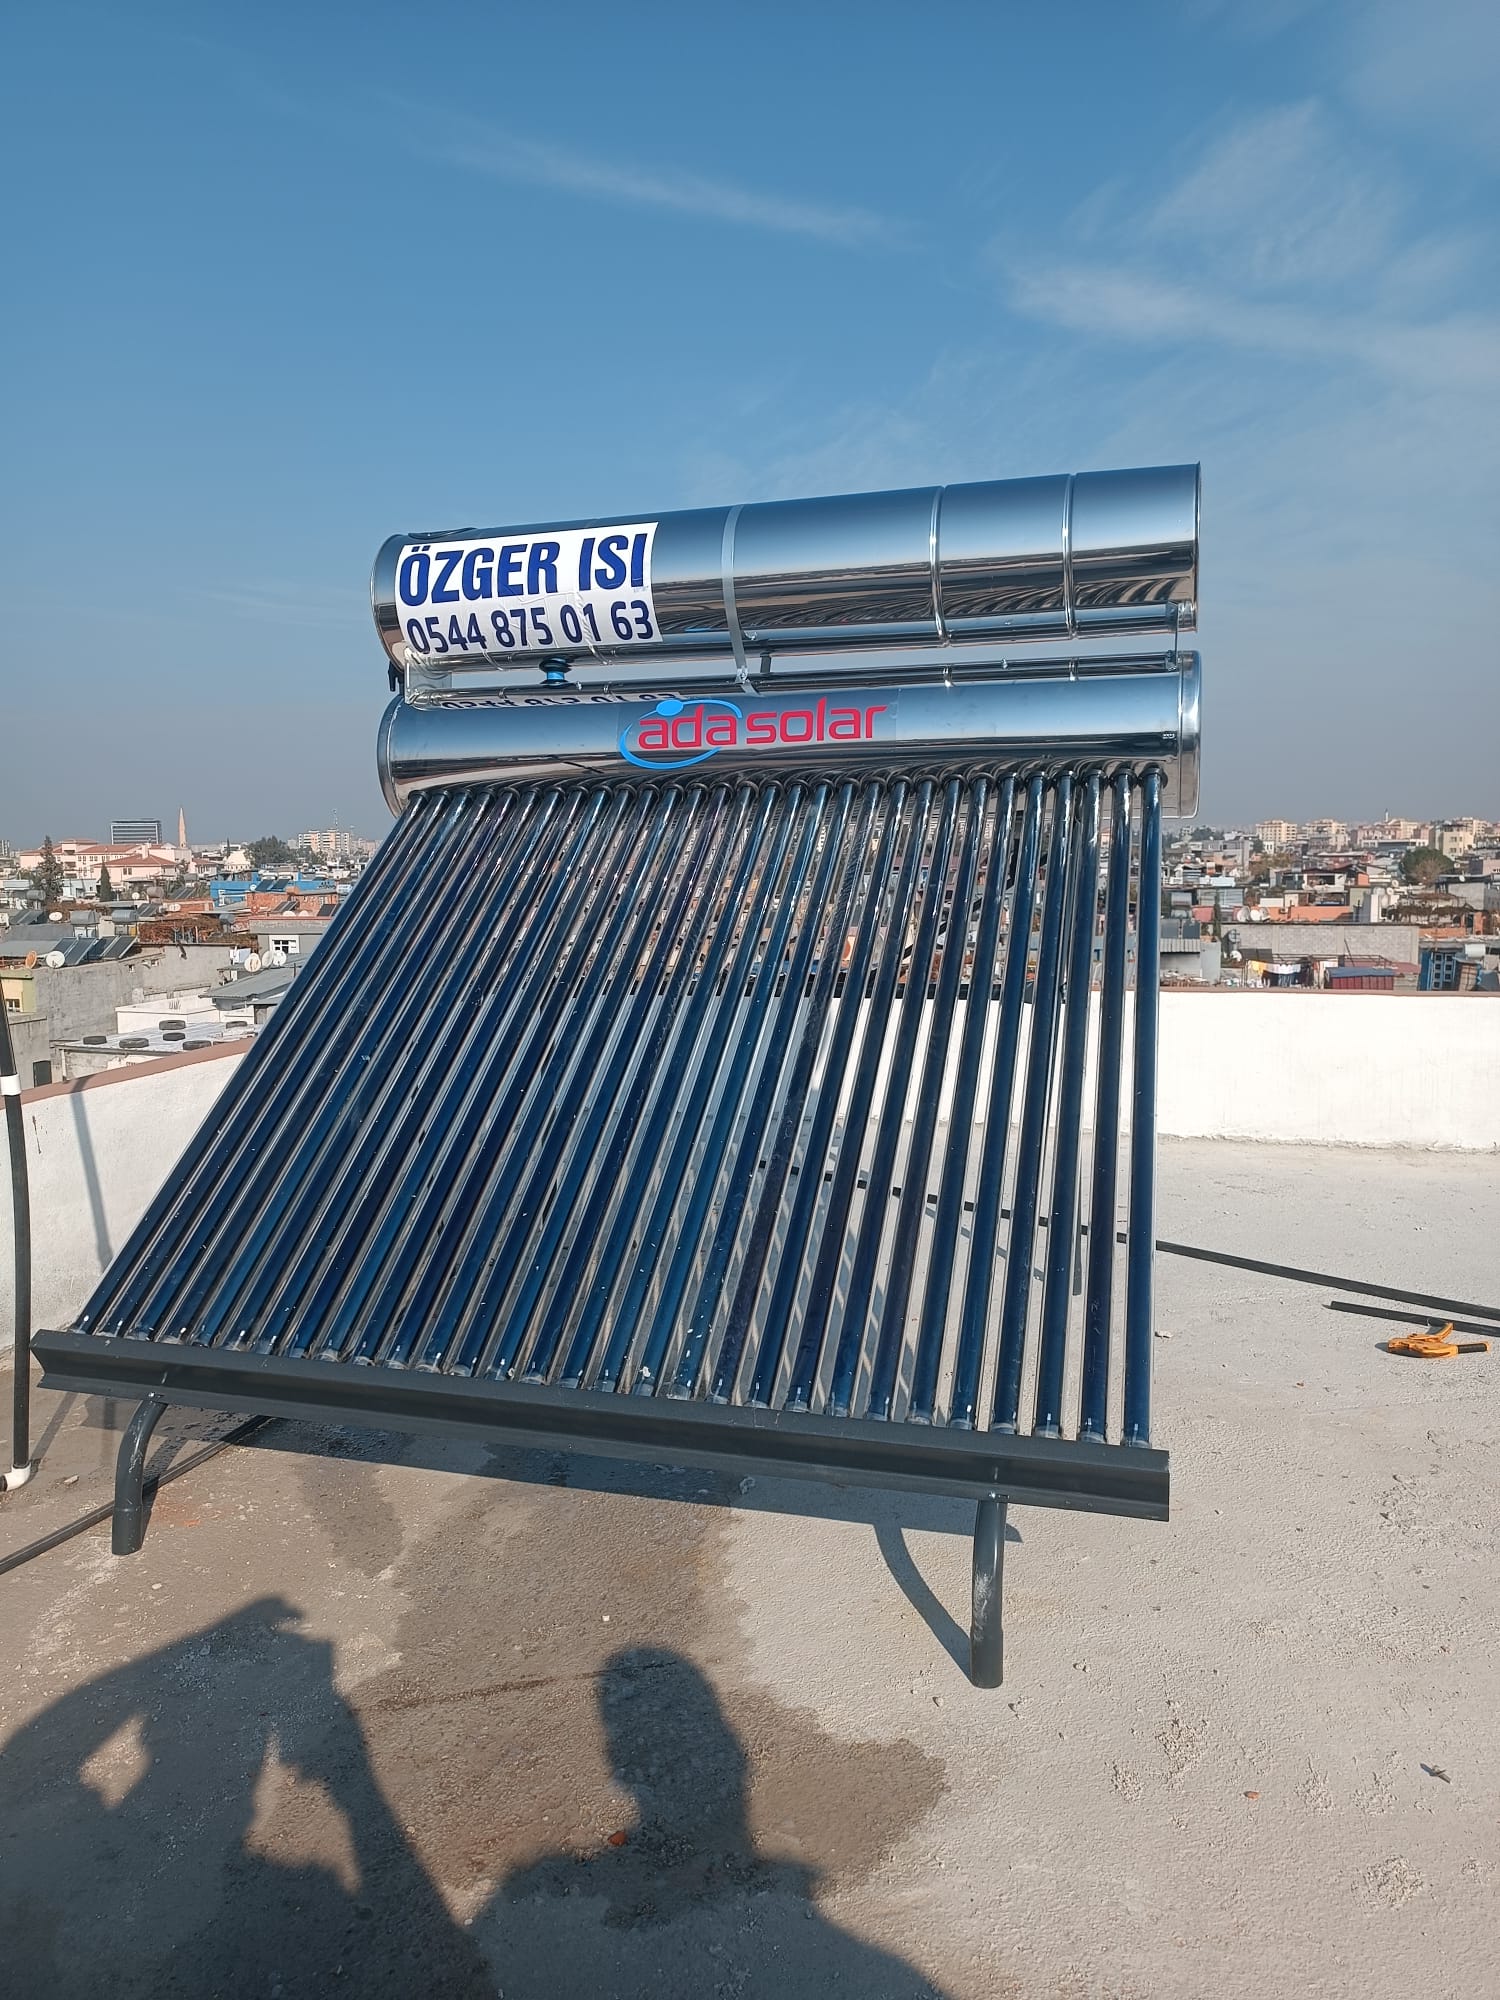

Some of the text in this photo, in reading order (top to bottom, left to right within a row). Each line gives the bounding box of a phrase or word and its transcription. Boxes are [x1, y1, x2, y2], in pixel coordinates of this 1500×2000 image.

[399, 533, 648, 606] ÖZGER ISI
[406, 600, 654, 654] 0544 875 01 63
